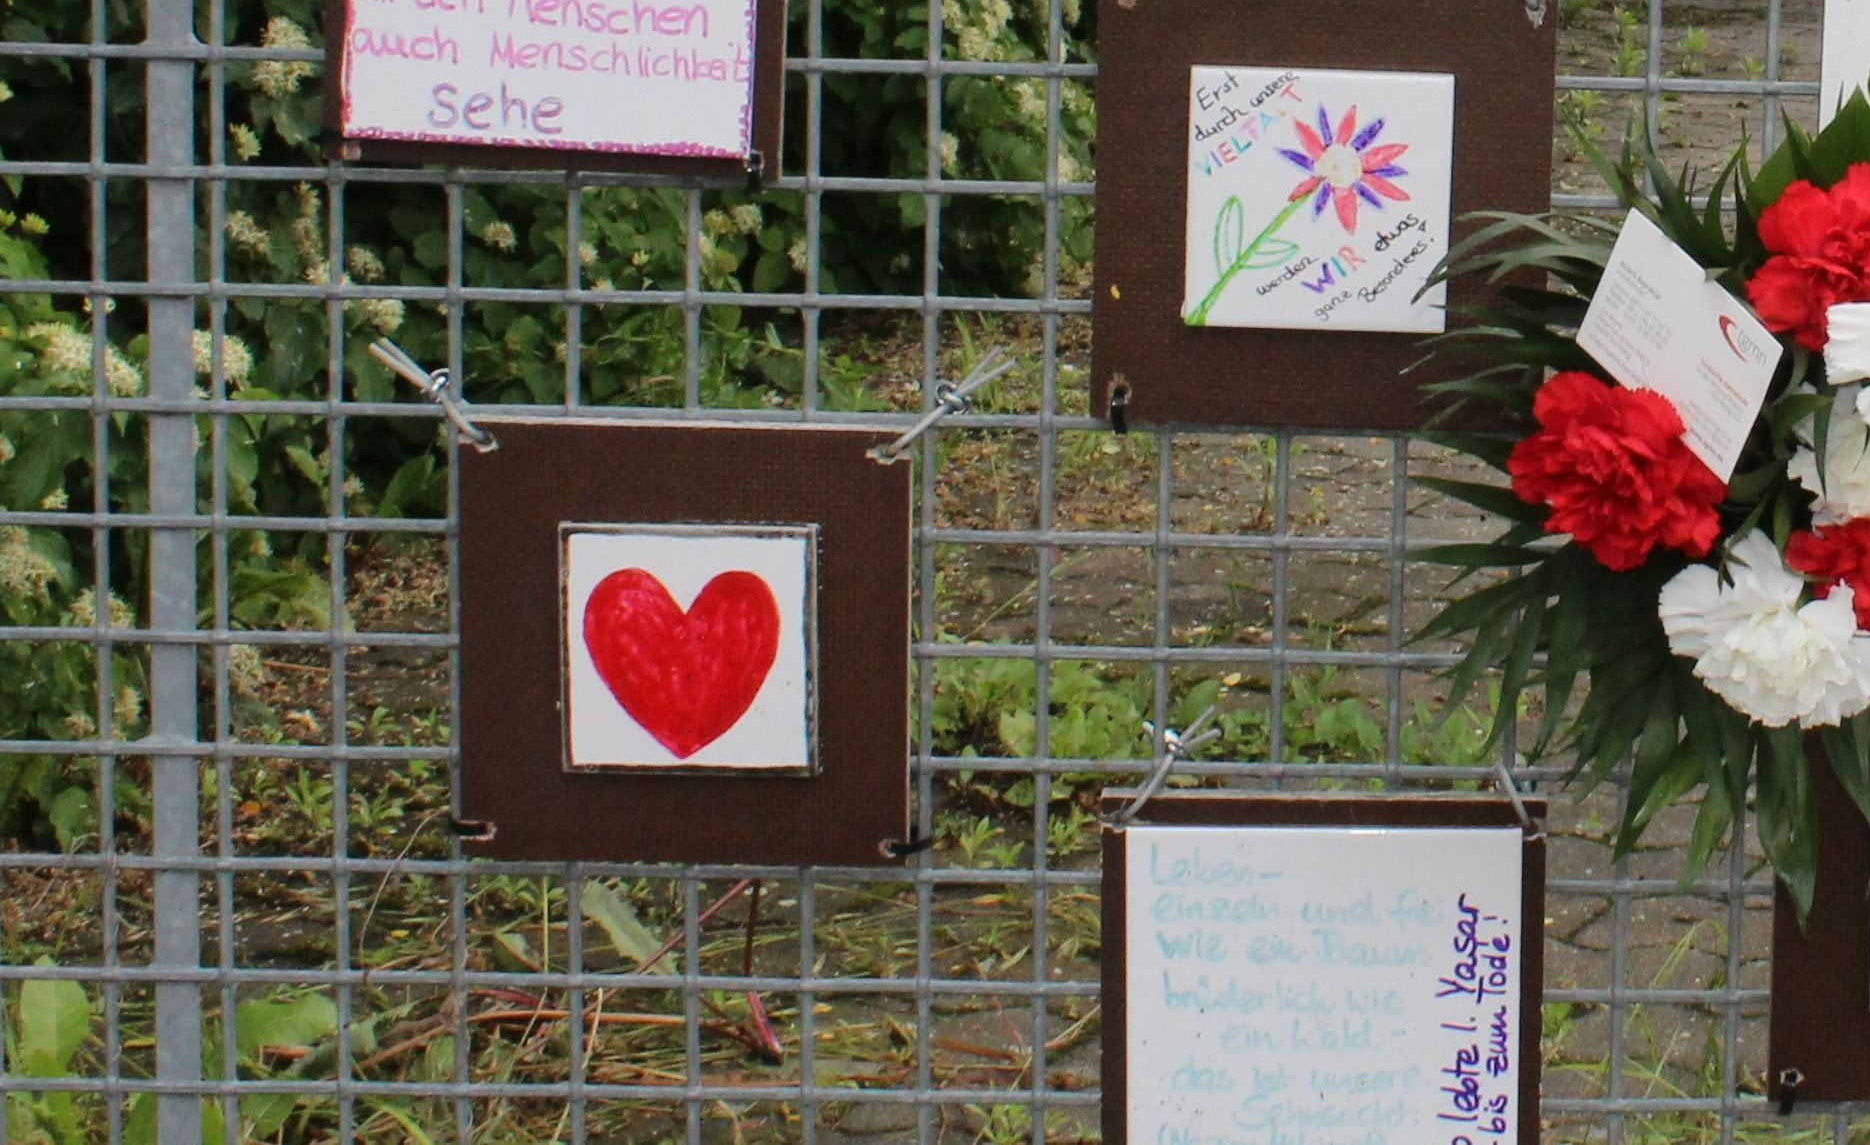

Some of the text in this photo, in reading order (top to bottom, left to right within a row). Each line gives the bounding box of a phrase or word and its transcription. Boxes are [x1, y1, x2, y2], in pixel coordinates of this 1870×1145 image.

[351, 26, 751, 84] auch Menschlichkeit
[1196, 71, 1240, 112] Erst
[1193, 81, 1304, 178] VIELFAT
[1194, 71, 1301, 142] durch unsere
[1256, 213, 1420, 296] werden WIR etwas
[1314, 289, 1355, 323] ganz
[1475, 914, 1512, 1136] bis zum Tode!
[1436, 1044, 1481, 1123] lebte
